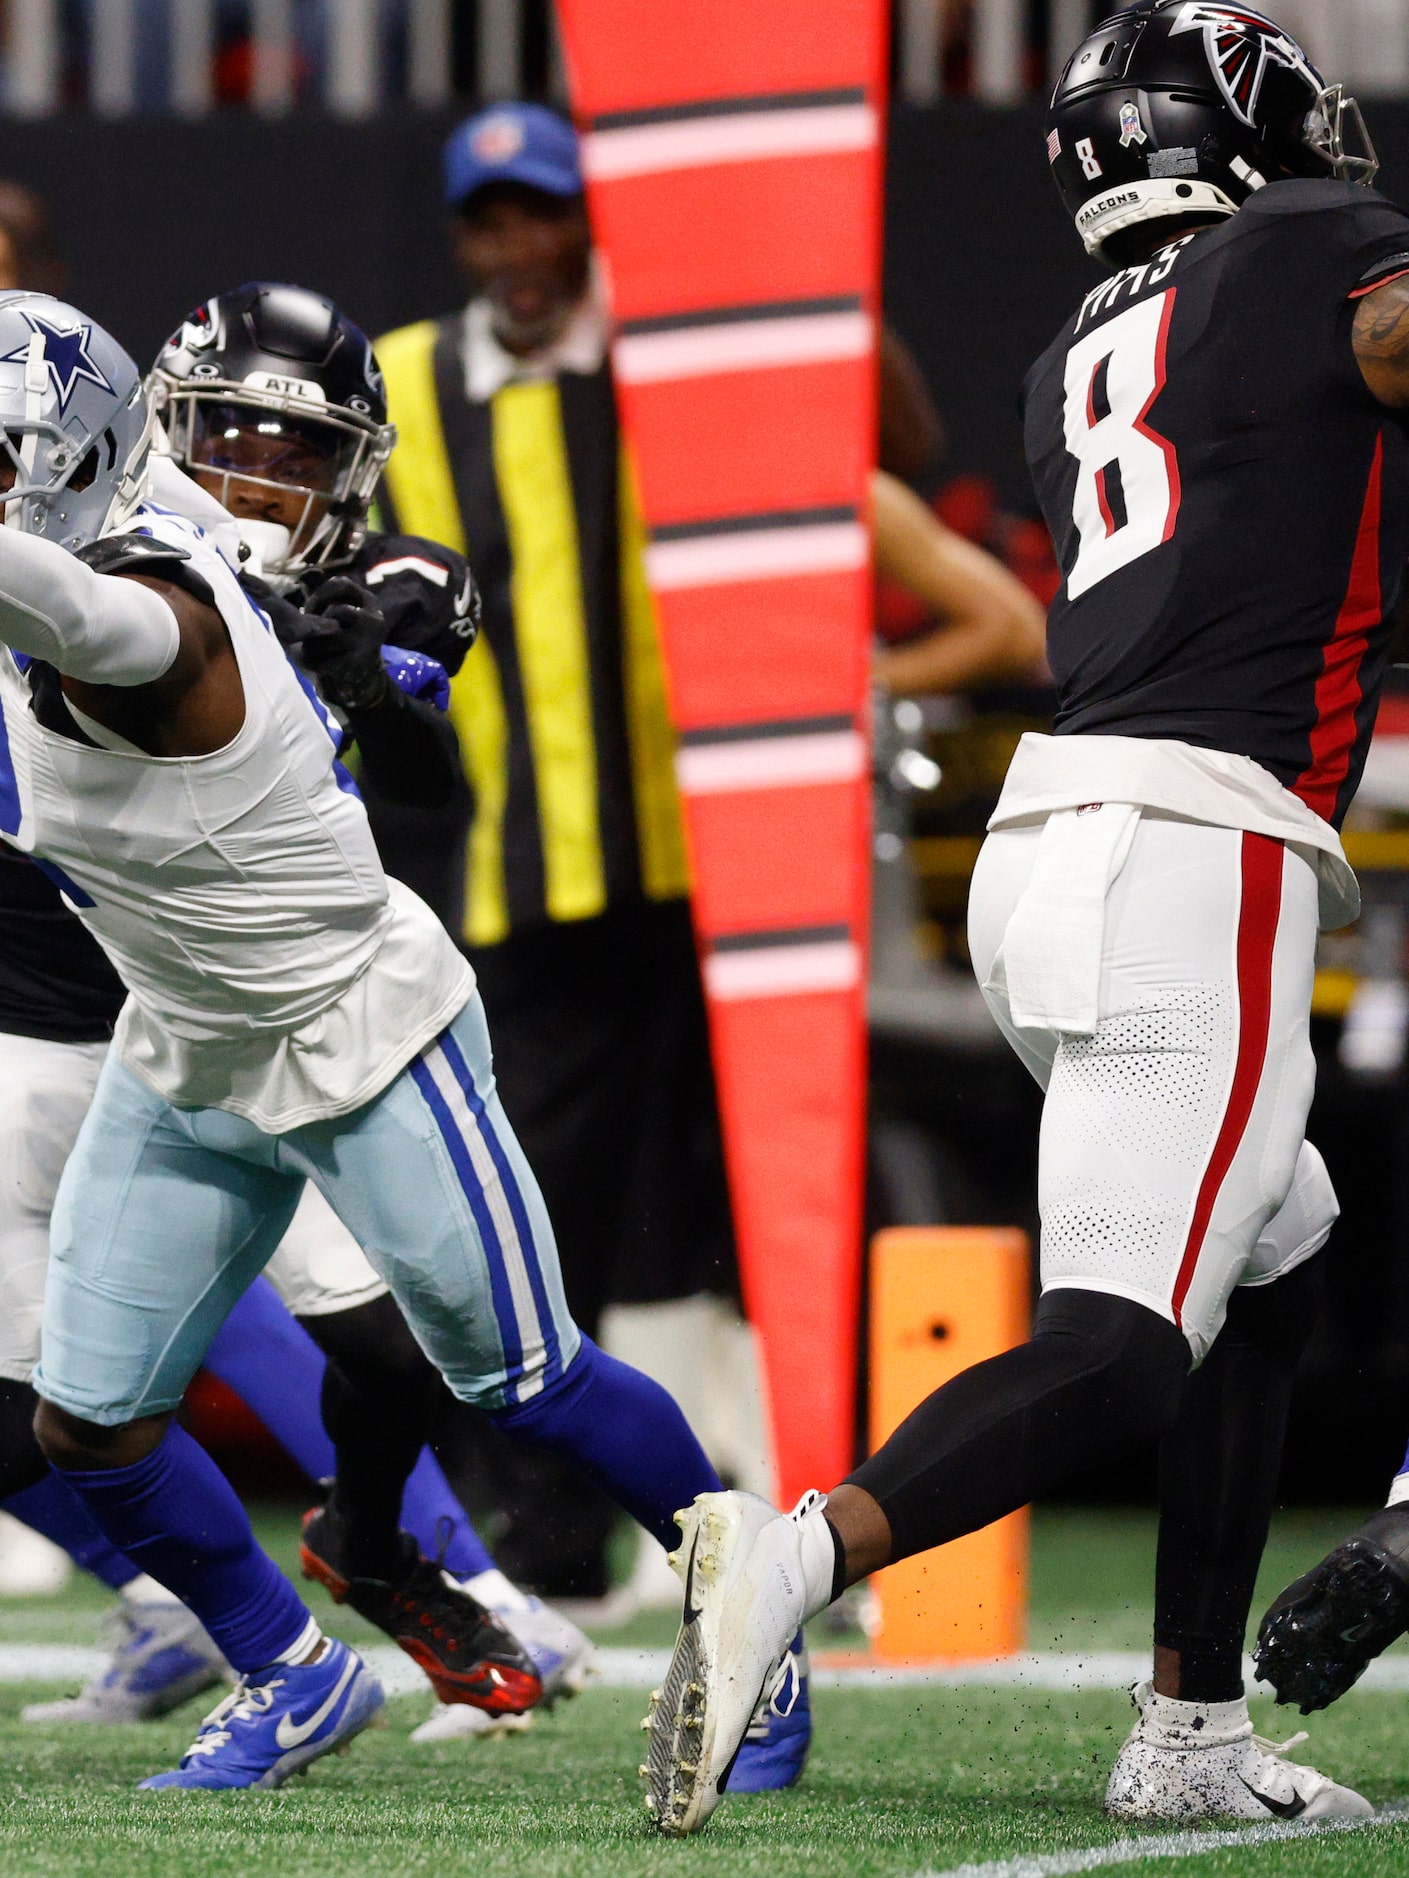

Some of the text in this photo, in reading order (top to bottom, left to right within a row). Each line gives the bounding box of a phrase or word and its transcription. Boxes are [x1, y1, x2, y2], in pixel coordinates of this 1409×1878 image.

[1074, 137, 1103, 181] 8
[1079, 191, 1139, 225] FALCONS
[1073, 234, 1195, 335] PITTS
[266, 378, 307, 396] ATL
[1063, 286, 1181, 601] 8
[776, 1560, 793, 1595] VAPOR
